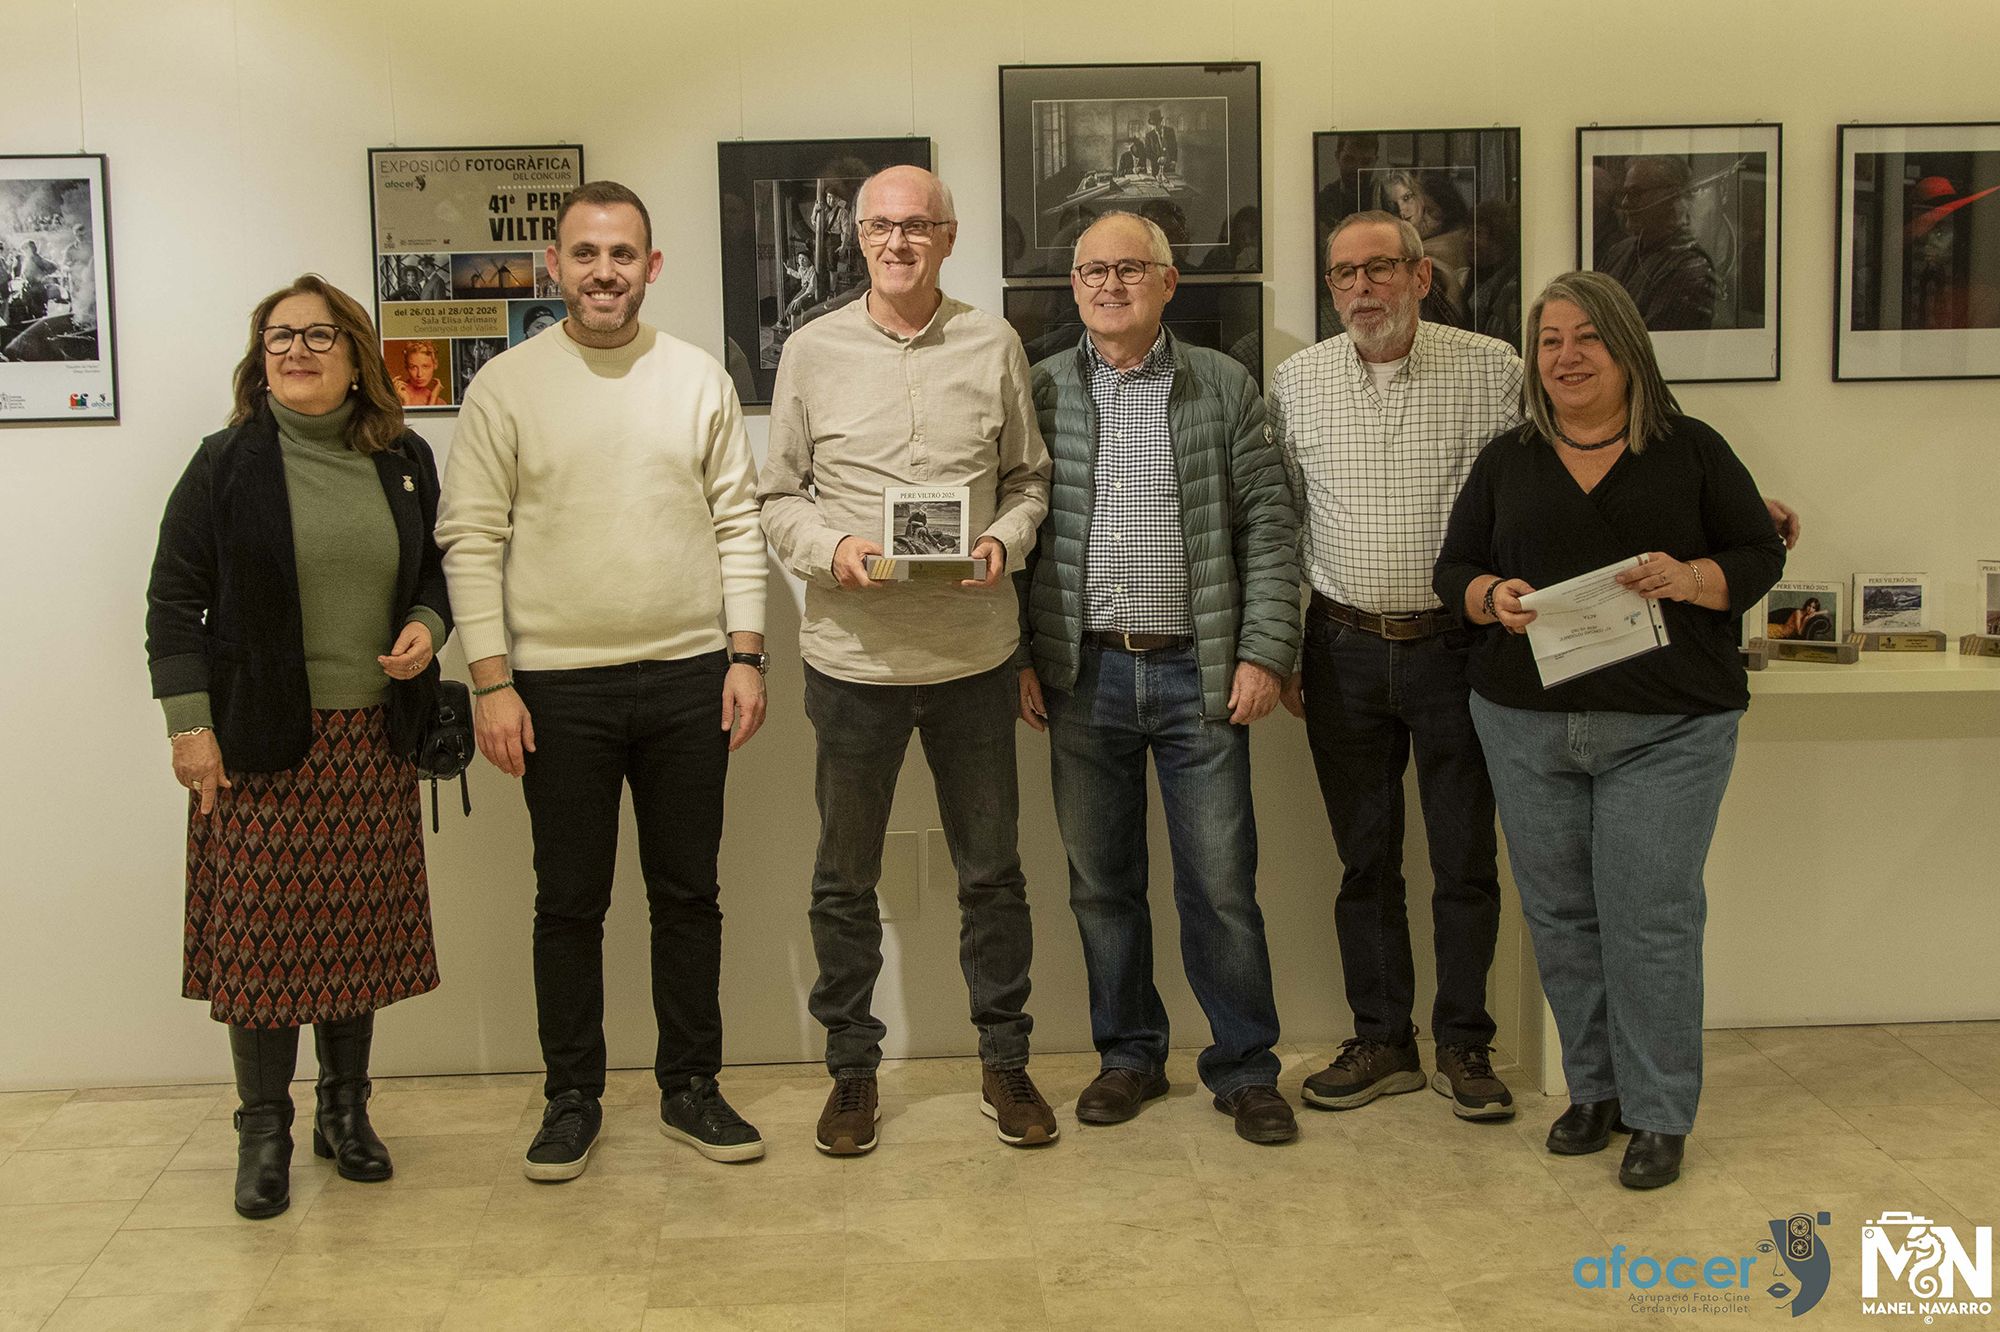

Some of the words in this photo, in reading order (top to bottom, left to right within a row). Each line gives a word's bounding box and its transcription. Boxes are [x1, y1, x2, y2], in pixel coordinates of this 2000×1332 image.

[380, 156, 460, 173] EXPOSICIÓ
[465, 154, 571, 171] FOTOGRÀFICA
[513, 172, 529, 180] DEL
[530, 171, 572, 180] CONCURS
[488, 216, 557, 242] VILTR
[394, 308, 407, 316] del
[409, 307, 436, 316] 26/01
[438, 307, 446, 315] al
[448, 307, 474, 315] 28/02
[476, 306, 498, 315] 2026
[421, 316, 439, 325] Sala
[441, 316, 462, 324] Elisa
[941, 491, 956, 499] 2025
